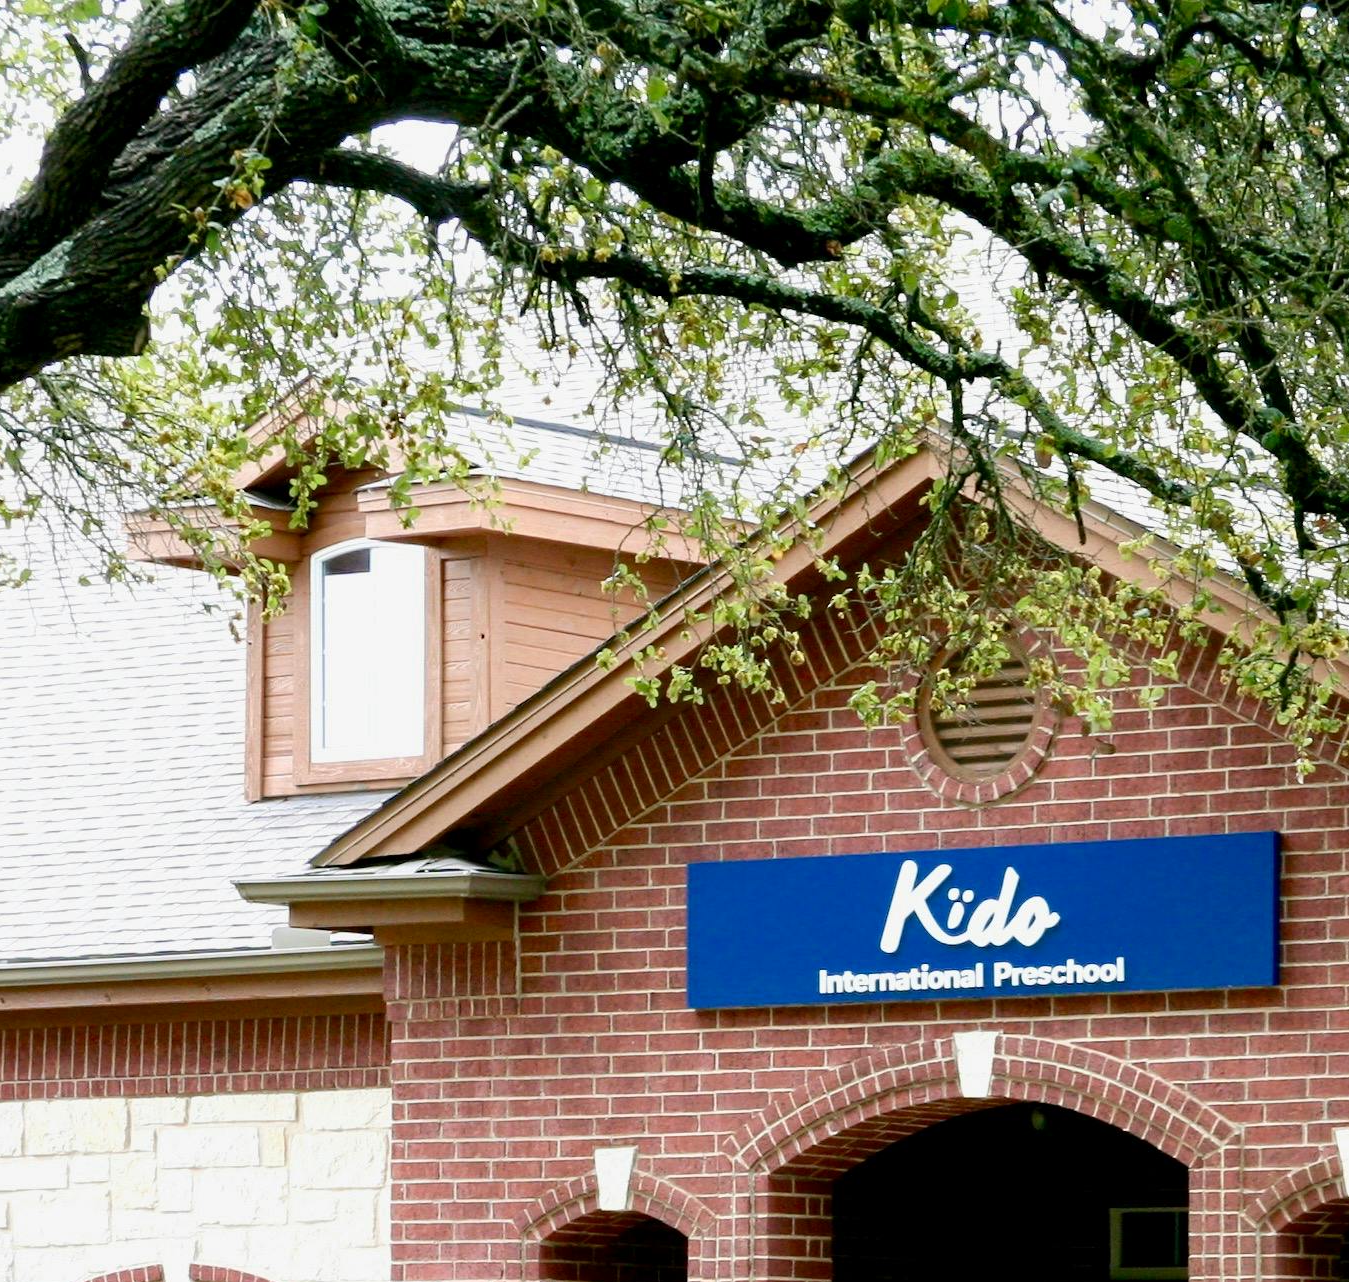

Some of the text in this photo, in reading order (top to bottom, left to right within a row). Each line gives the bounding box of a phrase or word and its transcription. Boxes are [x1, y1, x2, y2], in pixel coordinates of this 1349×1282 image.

[880, 860, 1061, 953] Kïdo
[819, 957, 1125, 994] International Preschool
